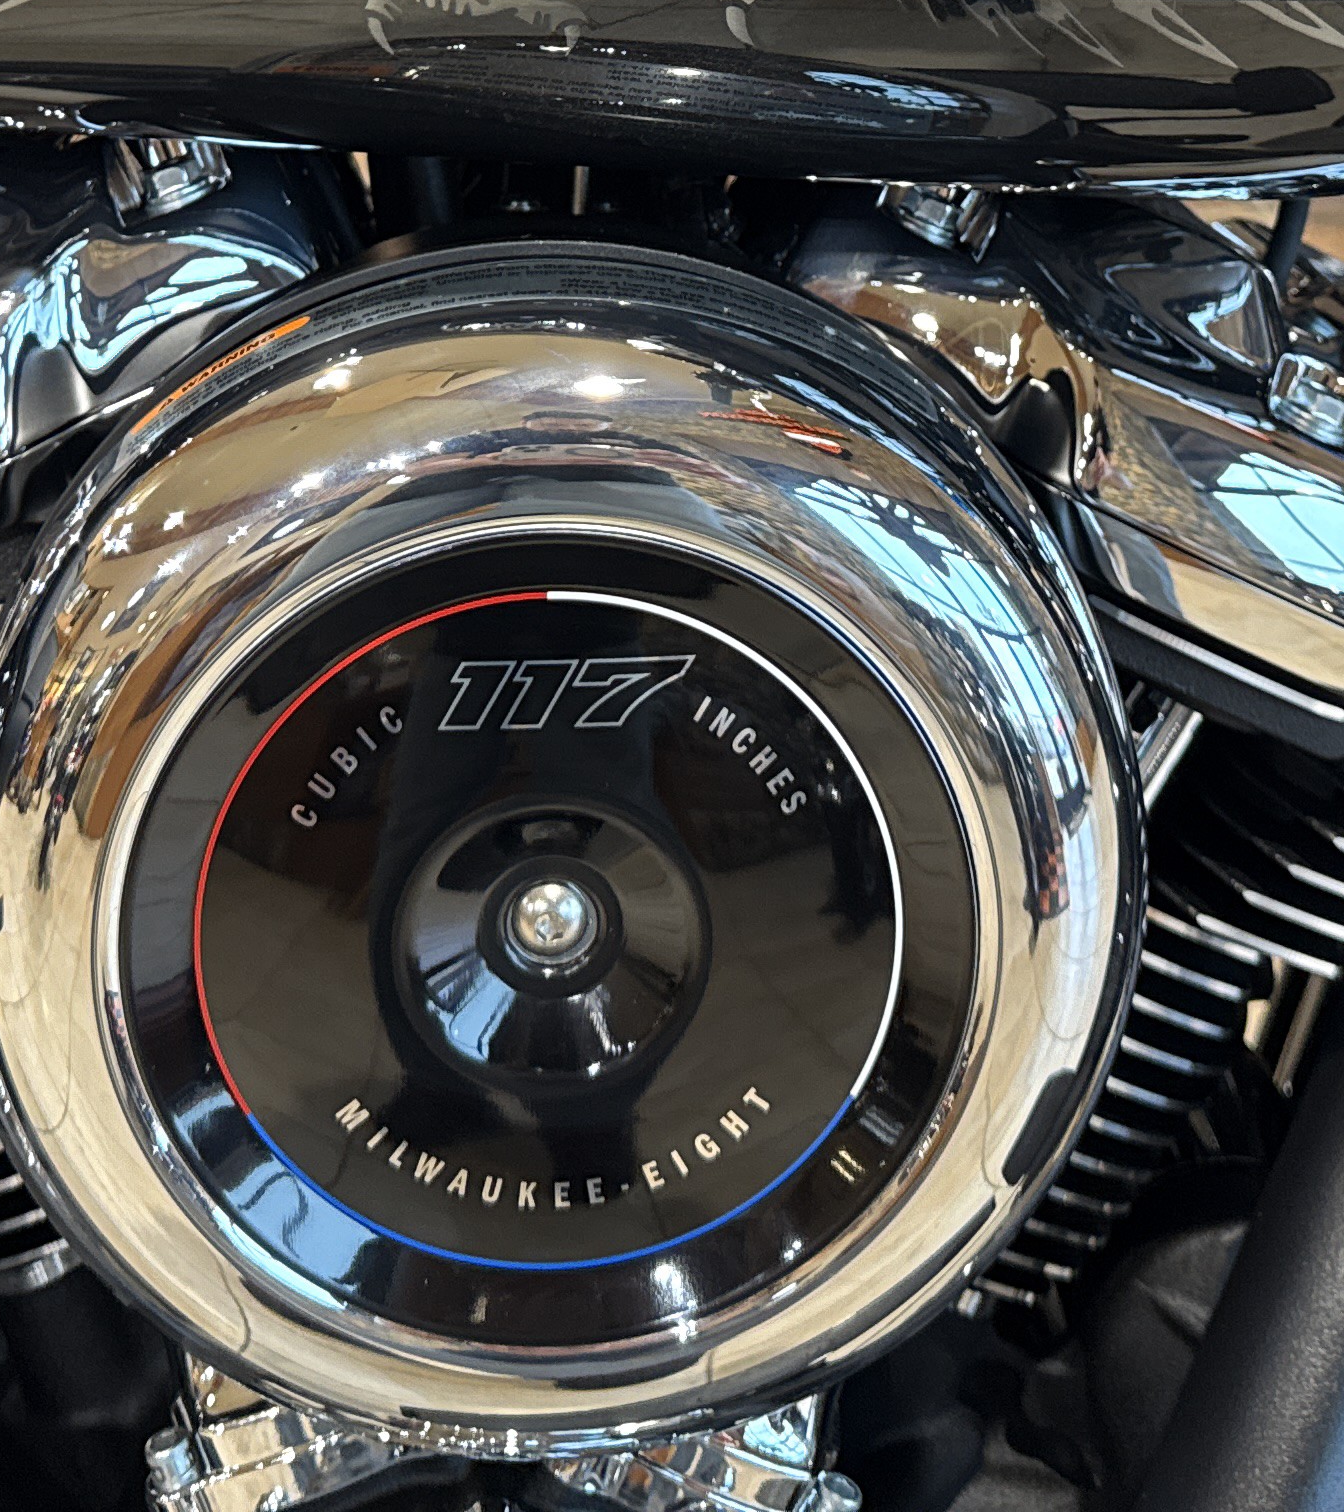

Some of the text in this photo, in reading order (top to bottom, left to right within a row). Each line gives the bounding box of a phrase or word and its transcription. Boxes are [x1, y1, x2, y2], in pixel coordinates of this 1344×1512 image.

[438, 653, 697, 733] 117
[290, 704, 405, 830] CUBIC
[693, 694, 810, 819] INCHES
[334, 1084, 774, 1211] MILWAUKEE-EIGHT
